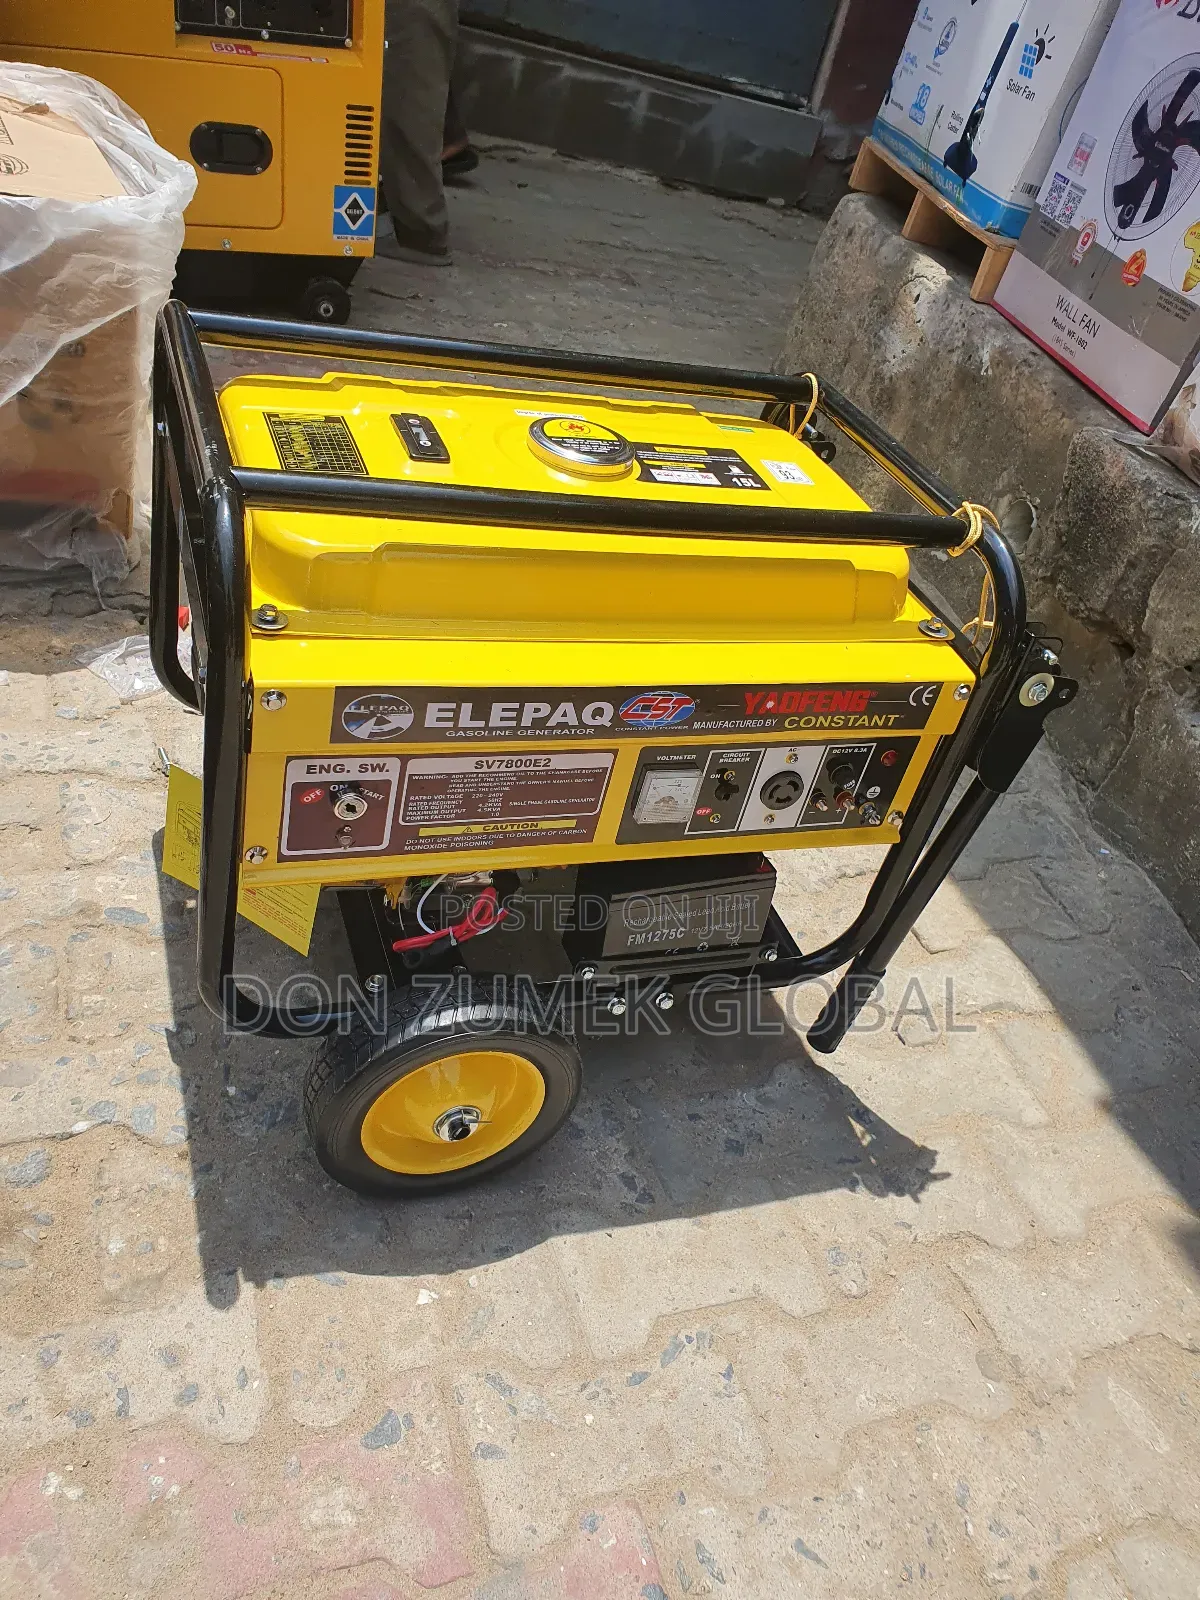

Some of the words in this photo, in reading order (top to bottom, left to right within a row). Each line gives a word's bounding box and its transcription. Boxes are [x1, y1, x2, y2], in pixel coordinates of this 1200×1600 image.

[214, 43, 235, 52] 50
[1006, 78, 1023, 95] Solar
[1021, 84, 1036, 102] Fan
[1055, 294, 1078, 324] WALL
[1078, 313, 1101, 339] FAN
[1051, 316, 1067, 333] Model
[1066, 329, 1089, 351] WF-1802
[732, 477, 761, 488] 15L
[909, 685, 937, 707] CE
[424, 701, 615, 728] ELEPAQ
[619, 696, 696, 720] CST
[692, 719, 763, 730] MANUFACTURED
[765, 718, 778, 727] BY
[784, 714, 900, 729] CONSTANT
[517, 728, 595, 736] GENERATOR
[305, 763, 351, 774] ENG.
[358, 762, 390, 774] SW.
[474, 758, 551, 770] SV7800E2
[303, 788, 322, 803] OFF
[329, 784, 348, 792] ON
[482, 822, 539, 831] CAUTION
[404, 843, 447, 851] MONOXIDE
[449, 840, 494, 848] POISONING
[627, 927, 686, 947] FM1275C
